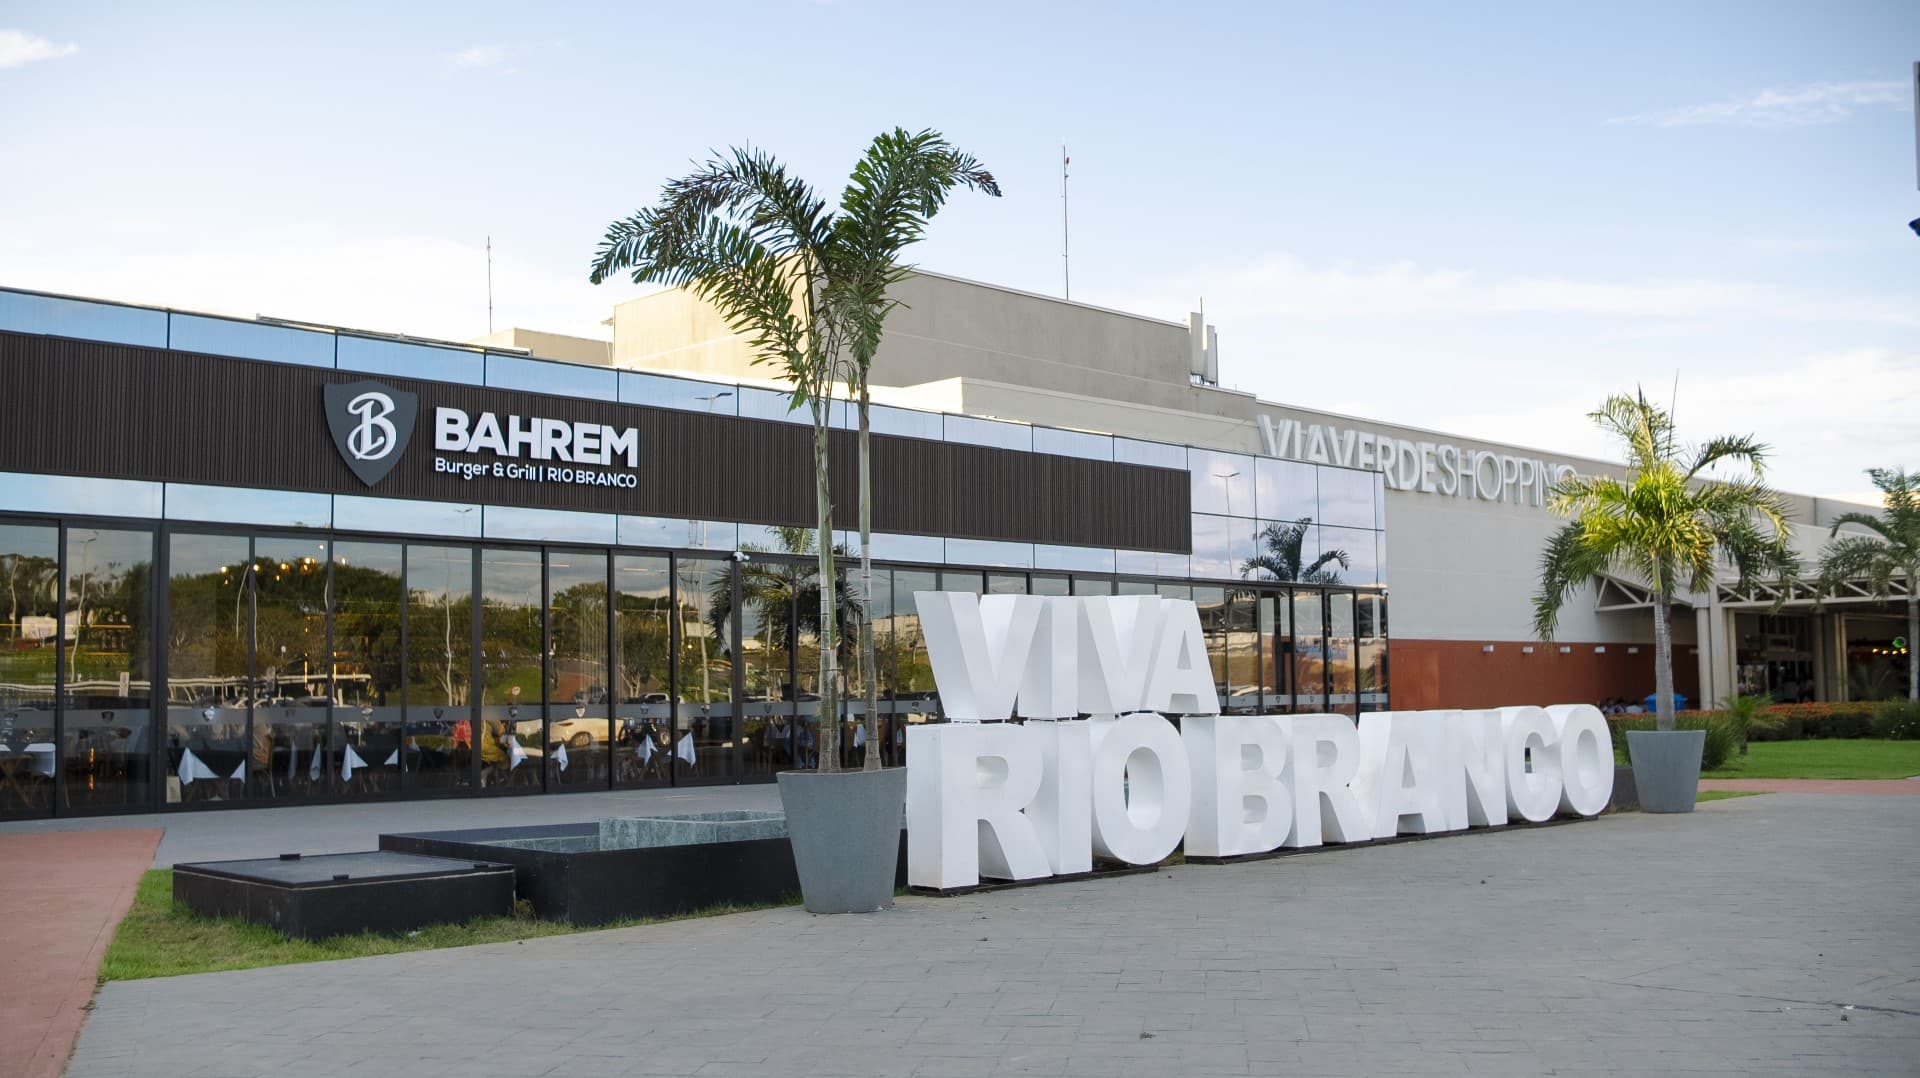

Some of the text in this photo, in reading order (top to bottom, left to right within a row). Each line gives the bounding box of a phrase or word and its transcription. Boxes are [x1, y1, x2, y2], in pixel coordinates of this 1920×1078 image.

[435, 406, 639, 468] BAHREM
[435, 457, 489, 480] Burger
[492, 462, 504, 478] &
[506, 463, 536, 480] Grill
[547, 467, 573, 483] RIO
[576, 470, 637, 488] BRANCO
[914, 591, 1221, 720] VIVA
[907, 704, 1615, 889] RIO BRANCO
